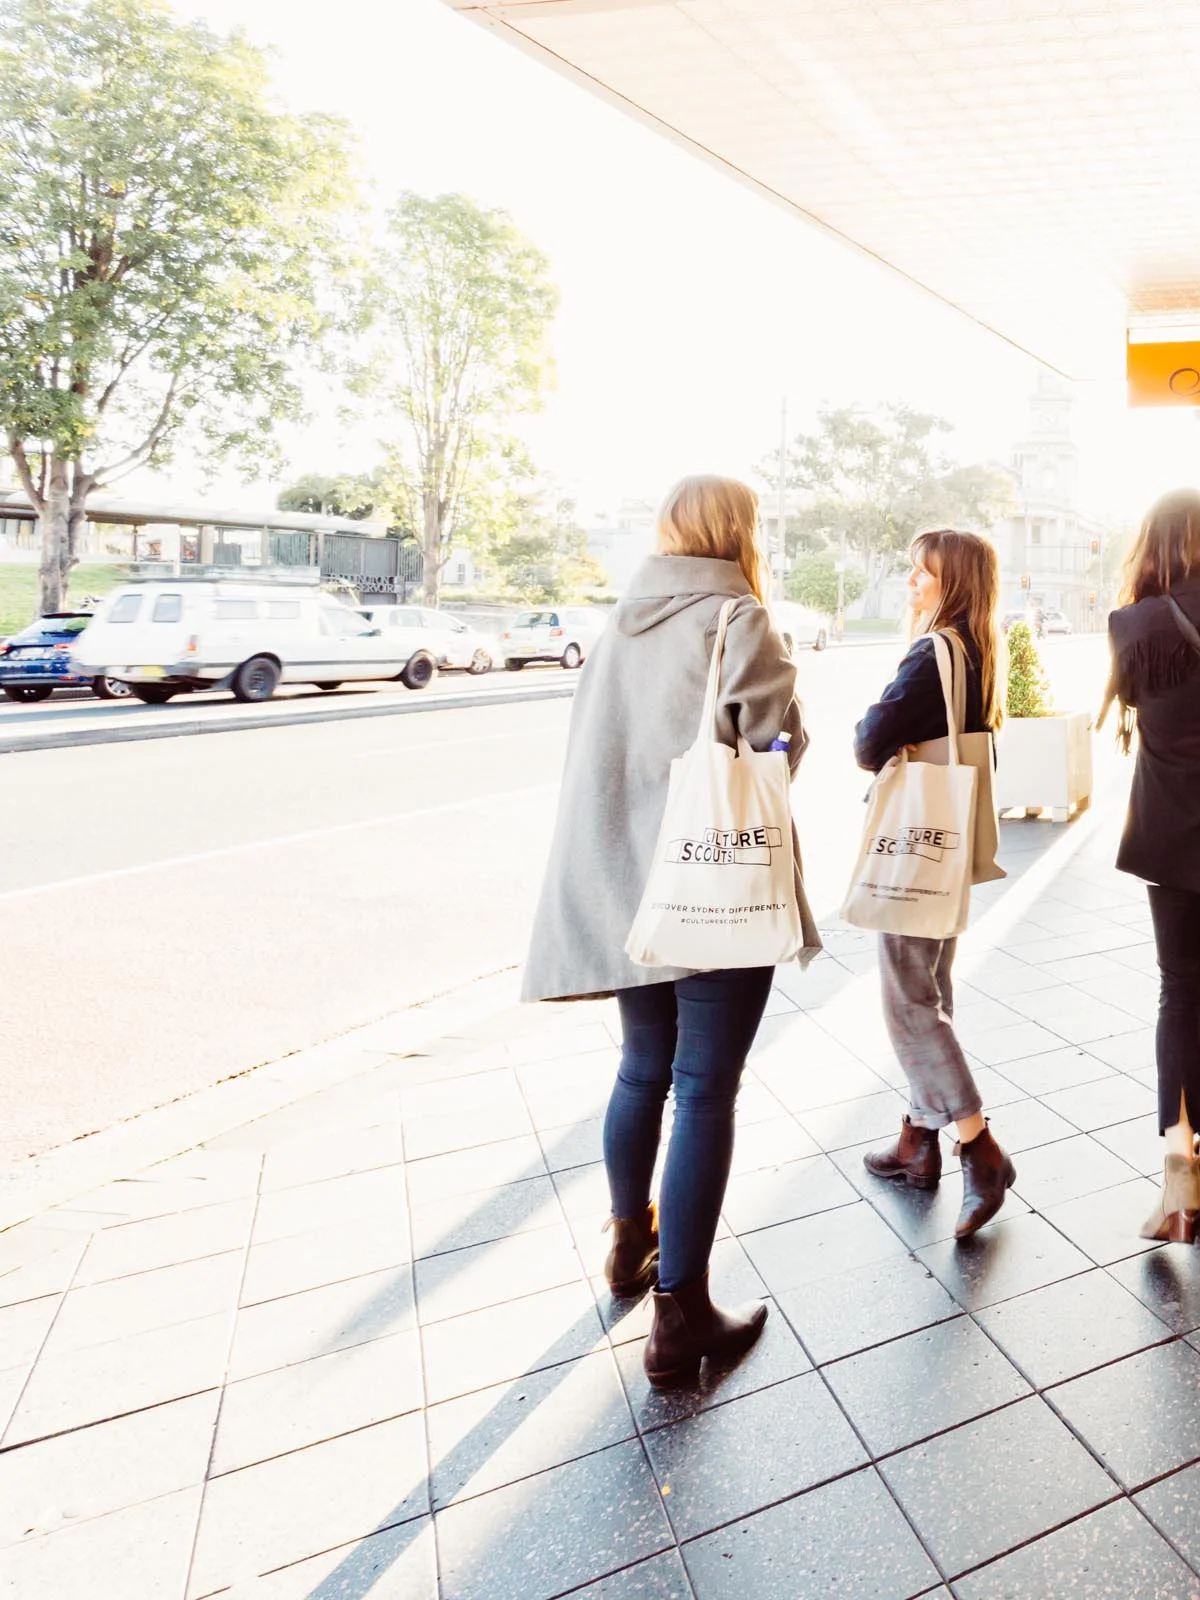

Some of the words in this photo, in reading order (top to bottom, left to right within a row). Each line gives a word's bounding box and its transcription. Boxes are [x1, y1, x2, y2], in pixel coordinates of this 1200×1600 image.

[681, 842, 733, 863] SCOUTS
[691, 905, 726, 914] SYDNEY
[728, 903, 788, 914] DIFFERENTLY
